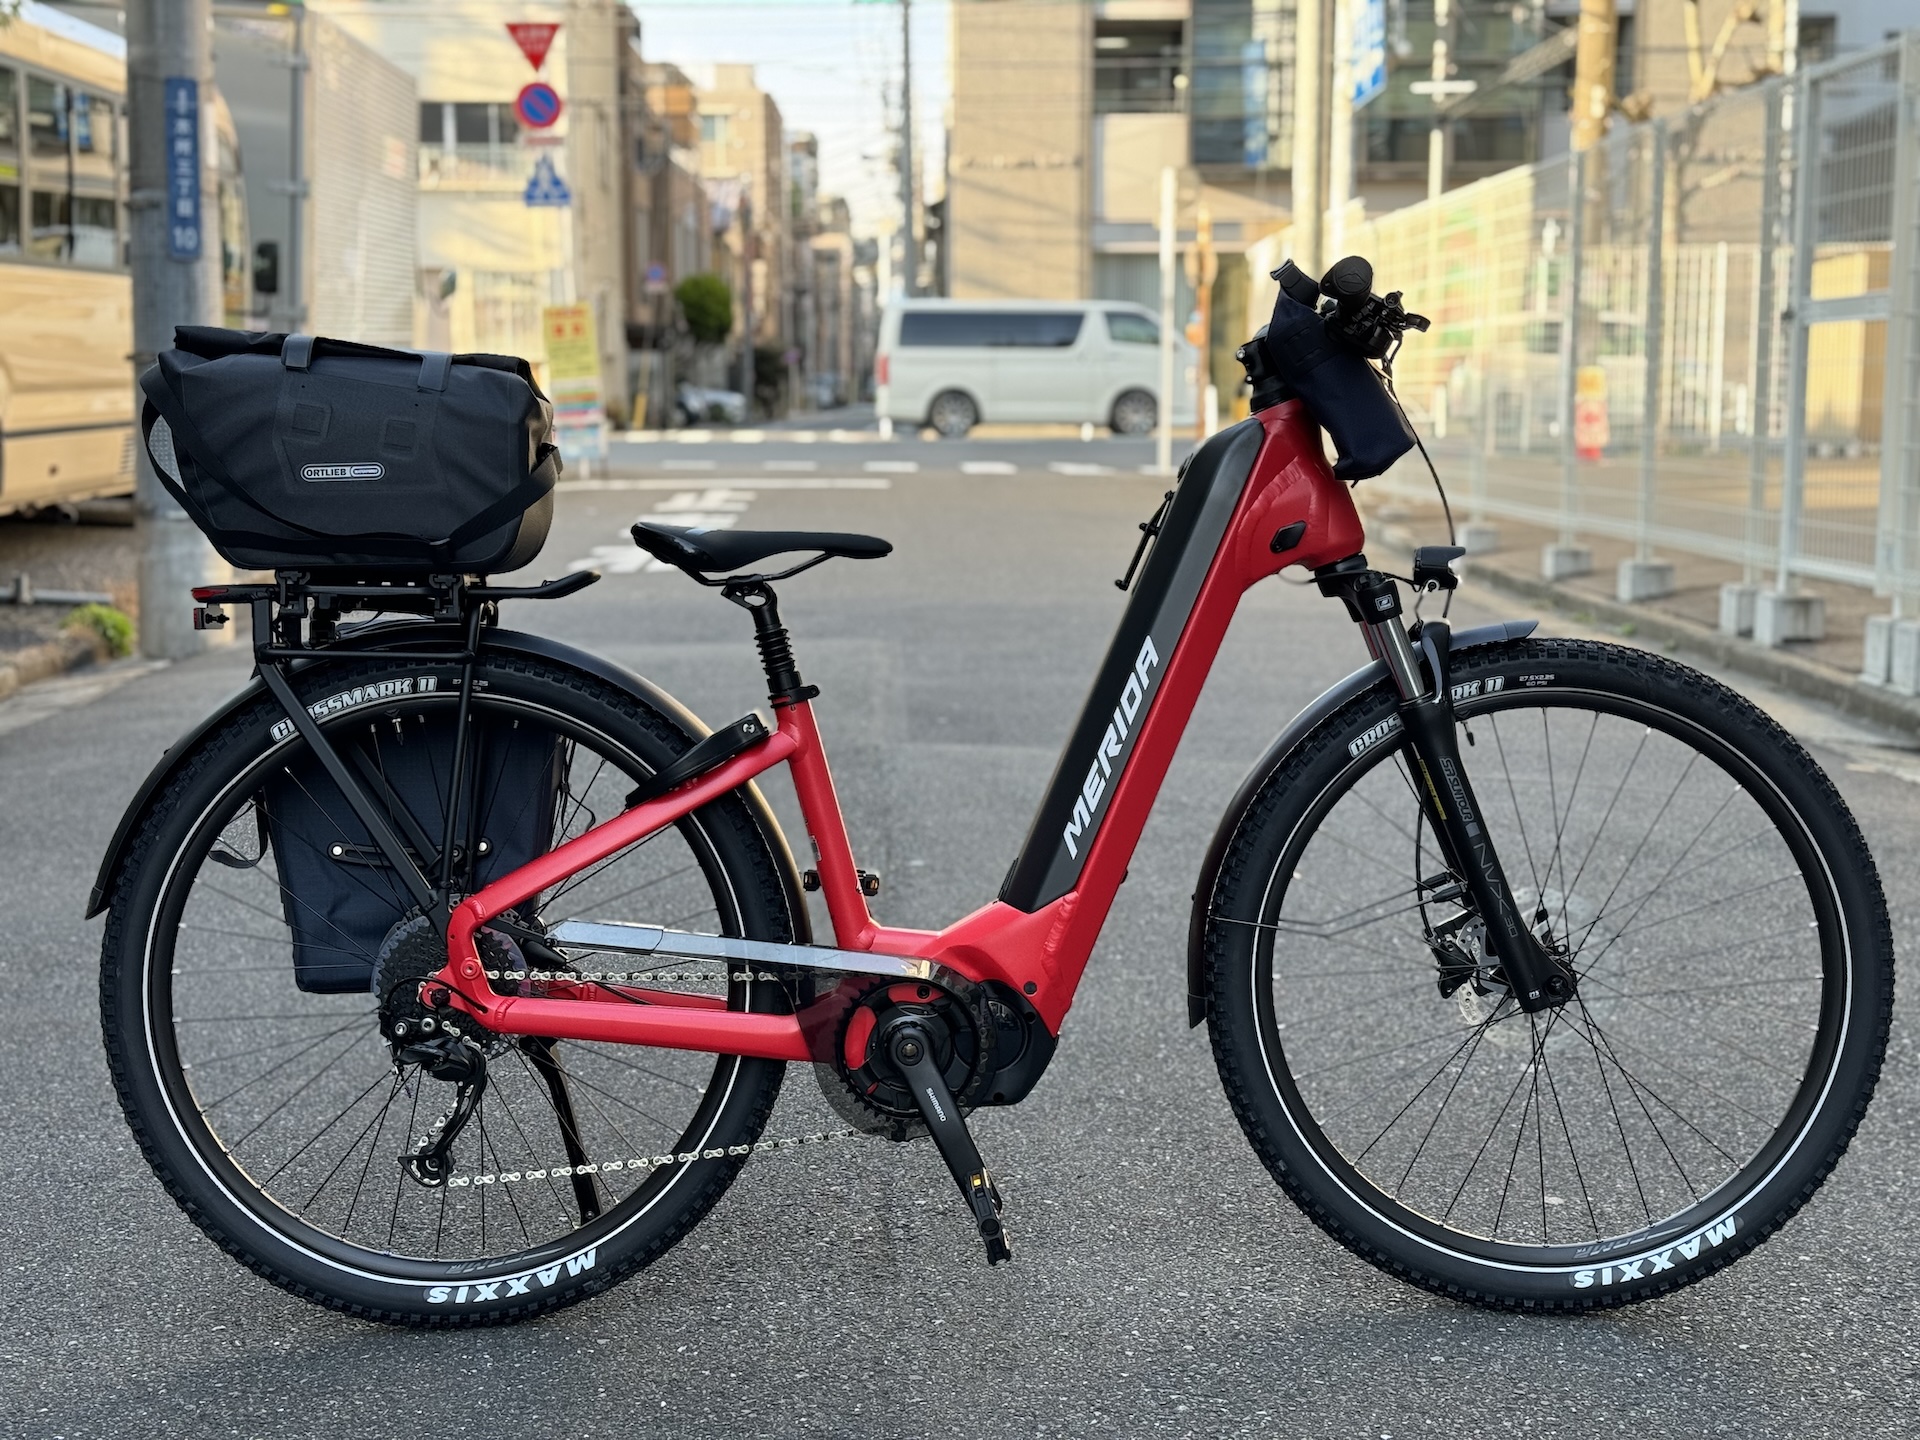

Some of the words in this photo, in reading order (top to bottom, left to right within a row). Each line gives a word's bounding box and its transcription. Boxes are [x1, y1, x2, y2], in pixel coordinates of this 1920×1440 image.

[173, 226, 198, 249] 10
[305, 468, 347, 477] ORTLIEB
[417, 675, 437, 693] II
[1485, 675, 1505, 693] II
[1063, 635, 1159, 860] MERIDA
[1449, 775, 1475, 822] SUNTOUR
[925, 1087, 947, 1122] SHIMANO
[1573, 1215, 1738, 1289] MAXXIS
[426, 1248, 597, 1304] MAXXIS
